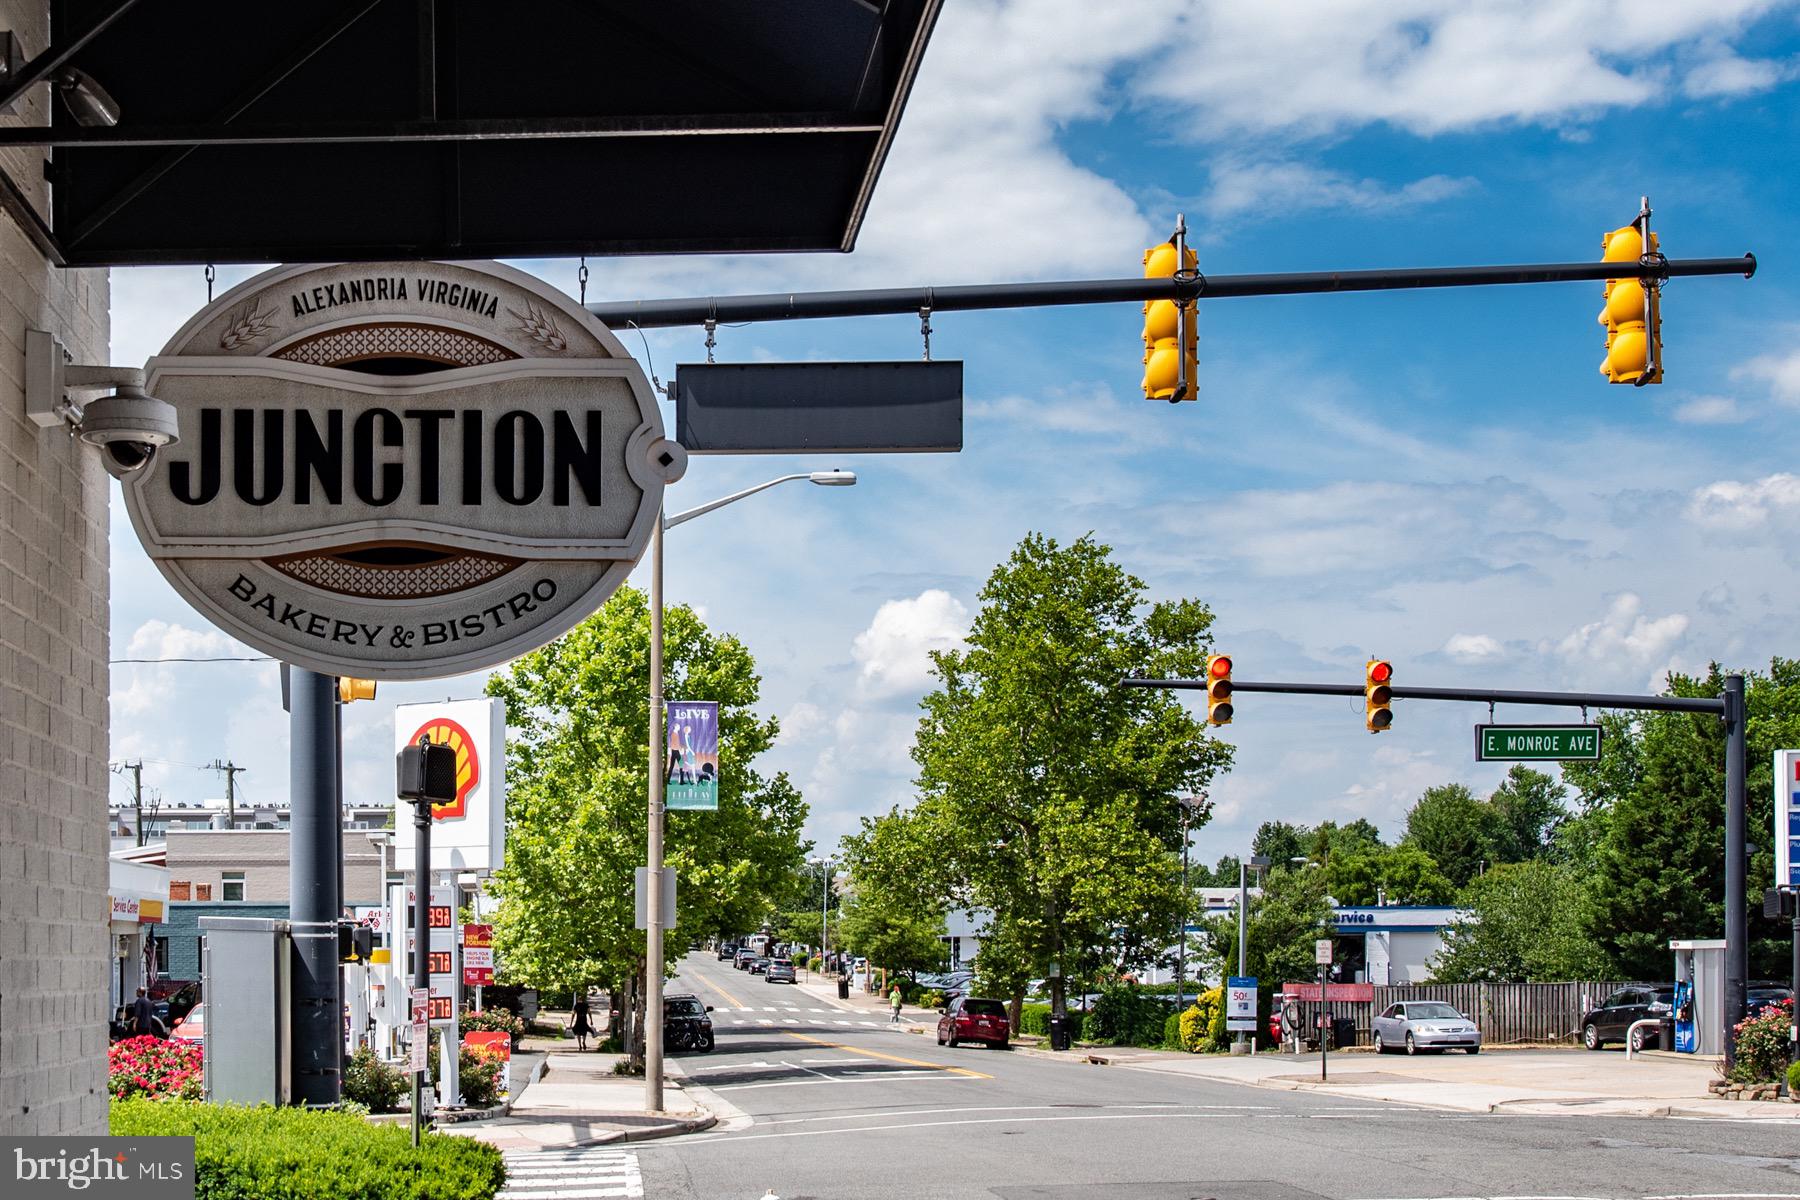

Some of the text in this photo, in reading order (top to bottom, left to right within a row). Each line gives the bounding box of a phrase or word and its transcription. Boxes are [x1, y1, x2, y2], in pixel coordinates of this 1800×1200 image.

[291, 278, 499, 319] ALEXANDRIA VIRGINIA
[169, 407, 603, 506] JUNCTION
[227, 573, 558, 648] BAKERY & BISTRO
[674, 708, 710, 720] LIVE
[1488, 736, 1593, 751] E. MONROE AVE
[113, 897, 139, 914] Service Center
[1332, 910, 1374, 923] ervice
